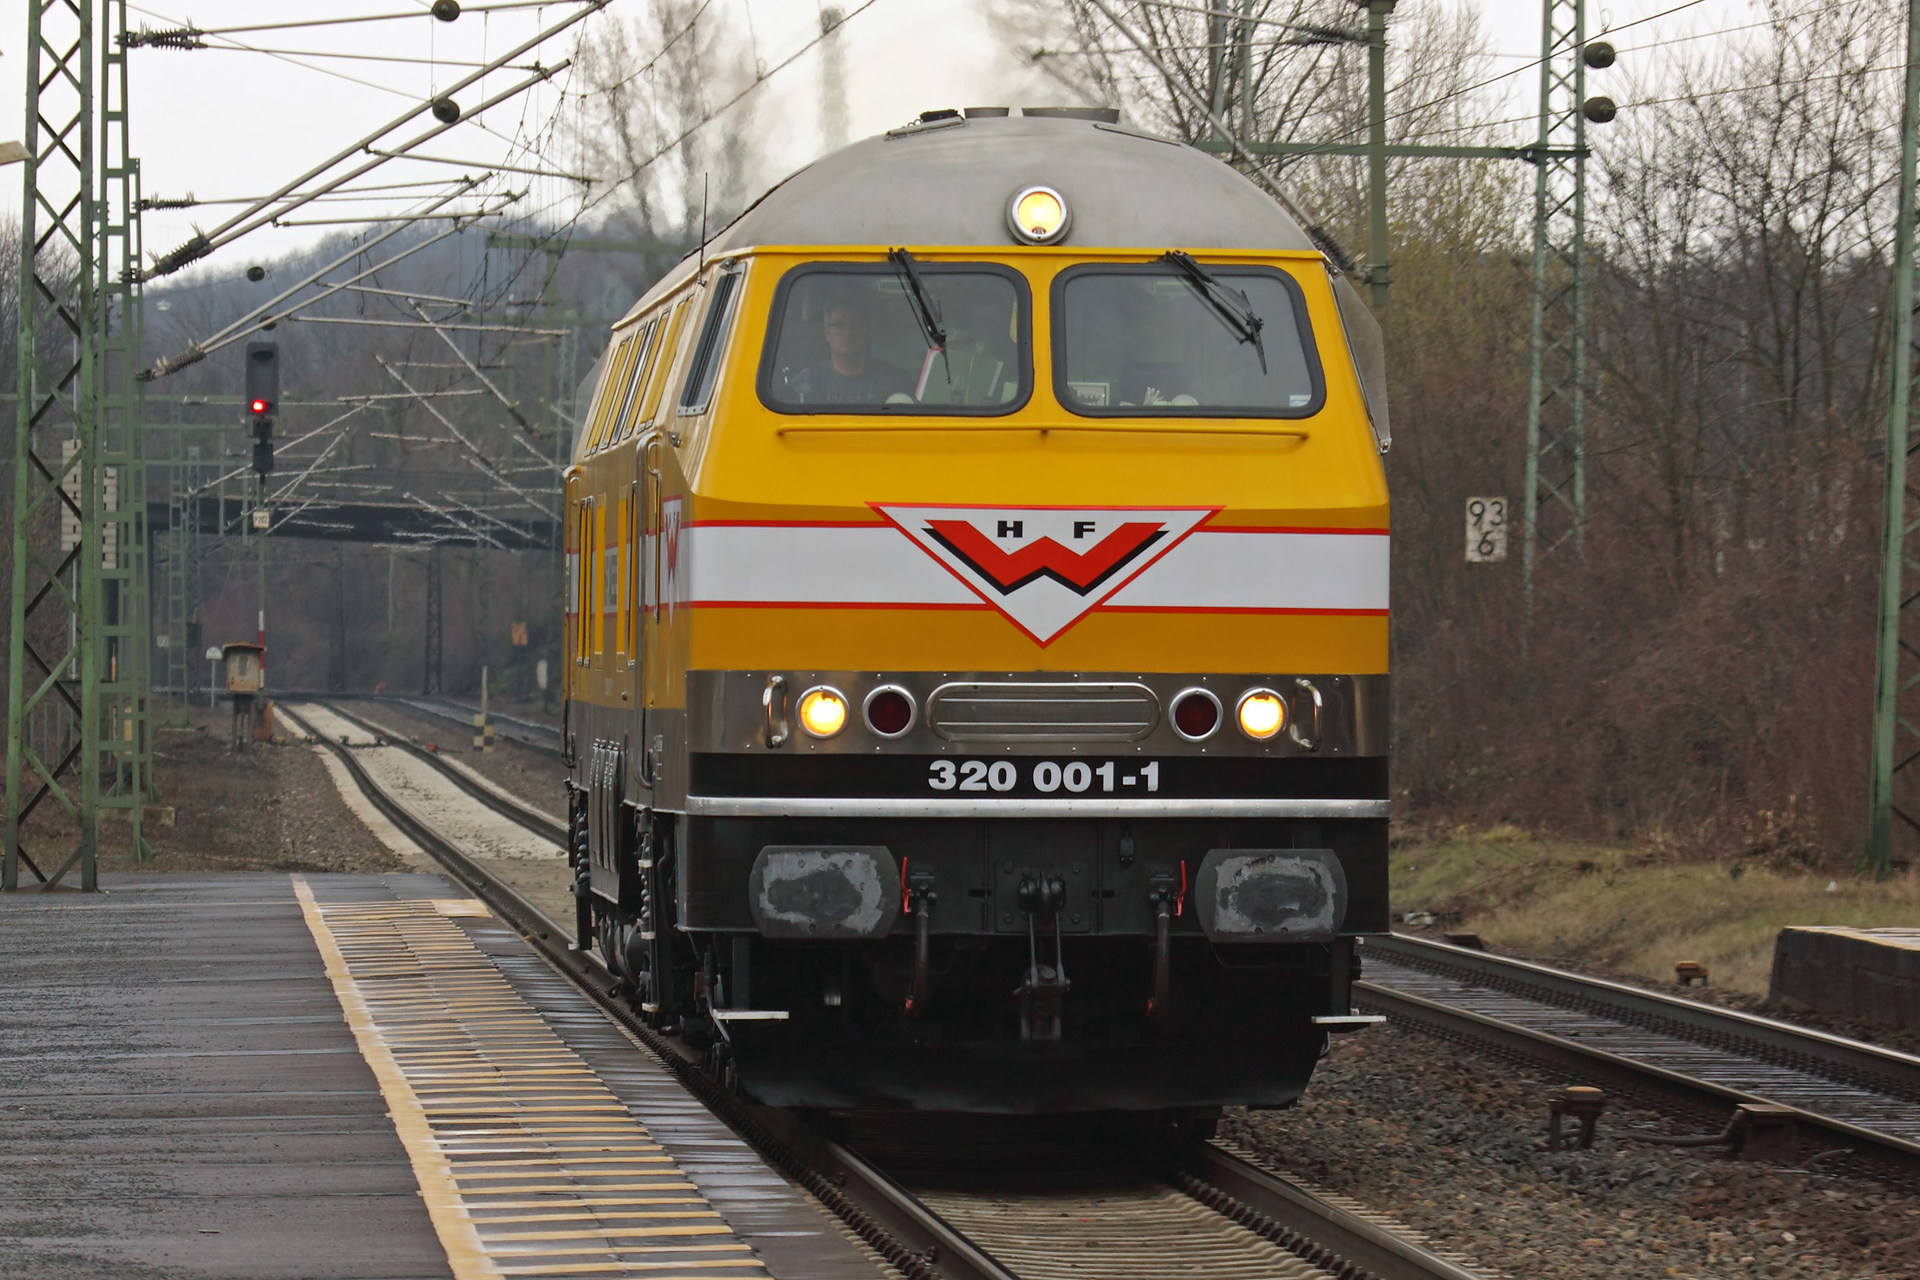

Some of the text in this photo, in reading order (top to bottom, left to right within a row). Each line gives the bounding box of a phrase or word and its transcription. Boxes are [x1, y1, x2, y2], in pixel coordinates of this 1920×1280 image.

[1469, 500, 1503, 527] 93
[997, 520, 1096, 539] H F
[1478, 530, 1494, 556] 6
[928, 759, 1159, 792] 320 001-1
